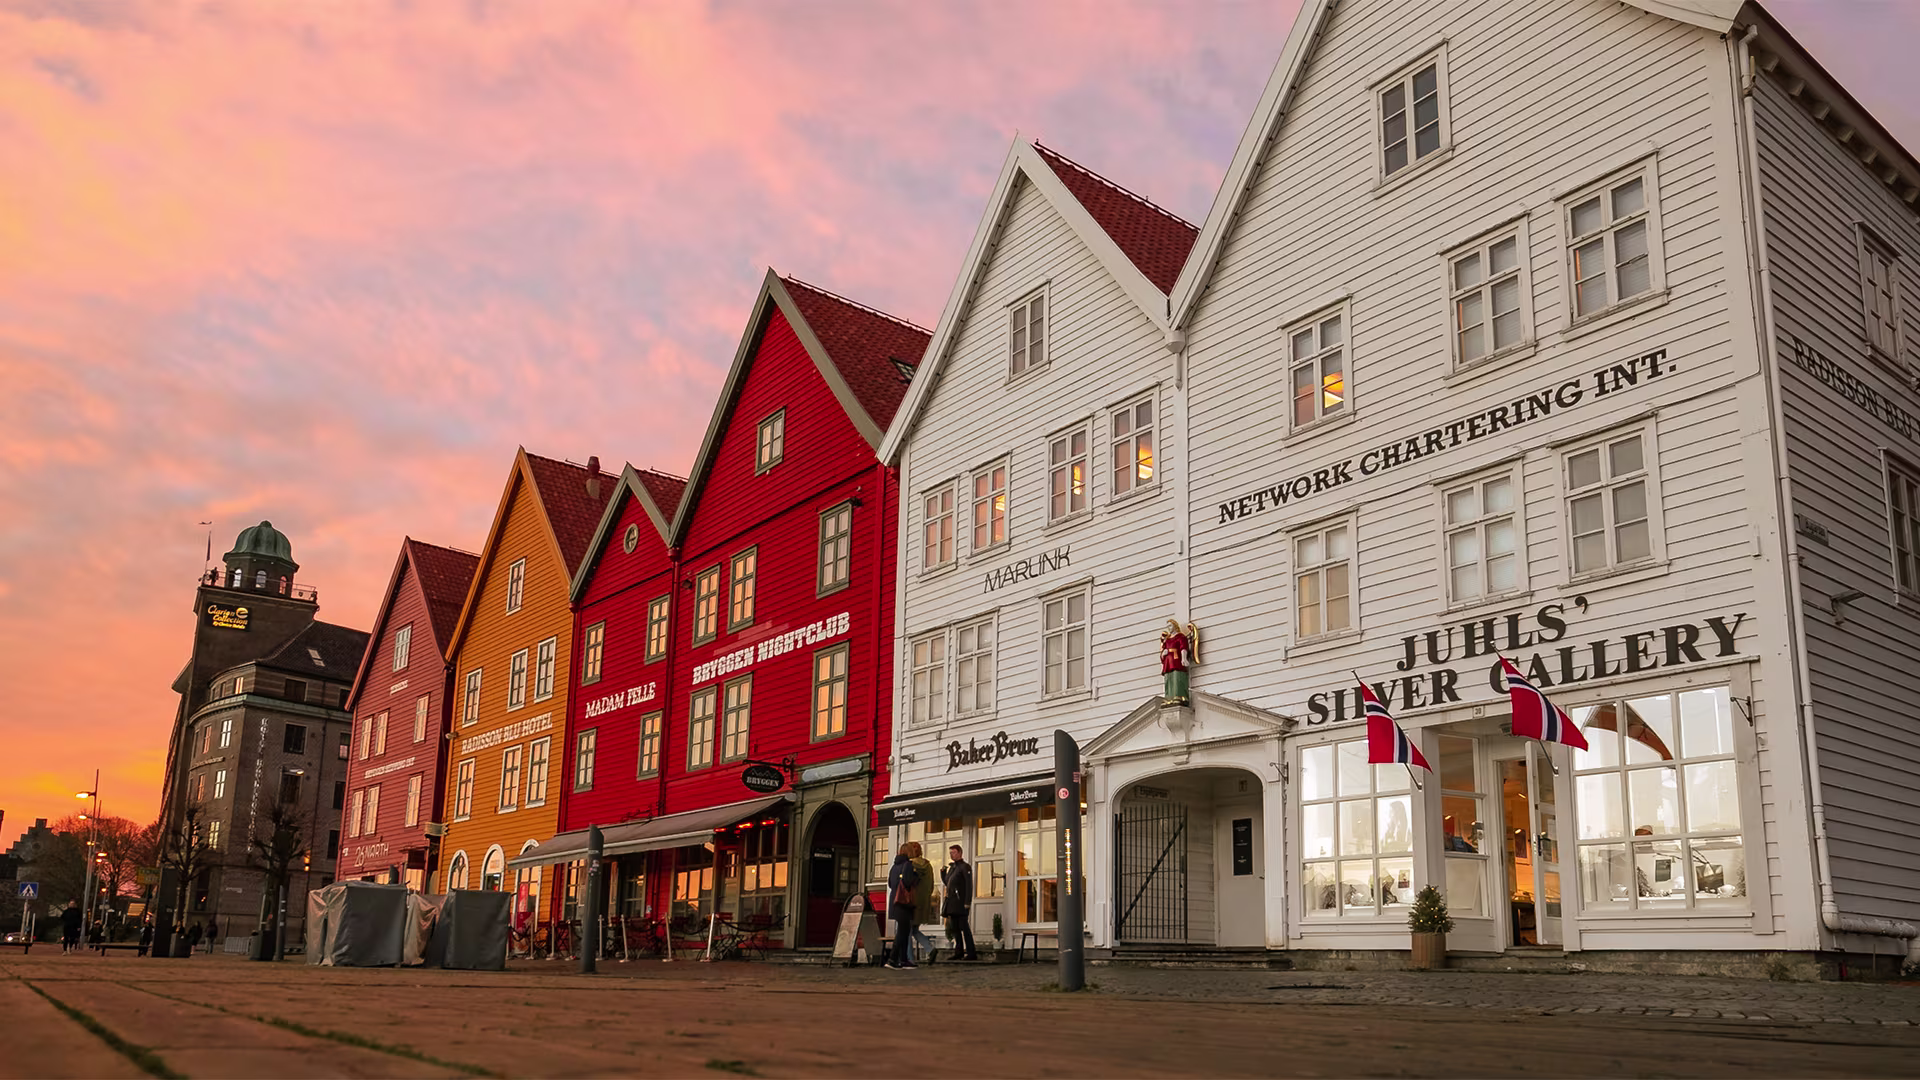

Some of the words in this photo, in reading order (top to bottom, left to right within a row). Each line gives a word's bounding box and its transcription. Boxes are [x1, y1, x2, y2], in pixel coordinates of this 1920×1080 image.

[1791, 336, 1880, 417] RADISSON
[1883, 397, 1912, 440] BLU
[1218, 459, 1353, 525] NETWORK
[1359, 379, 1584, 476] CHARTERING
[1594, 348, 1677, 398] INT.
[984, 545, 1071, 594] MARLINK
[207, 604, 235, 616] Clarion
[692, 645, 755, 686] BRYGGEN
[757, 611, 850, 663] NIGHTCLUB
[585, 691, 625, 719] MADAM
[461, 727, 503, 755] RADISSON
[503, 721, 521, 743] BLU
[521, 711, 553, 737] HOTEL
